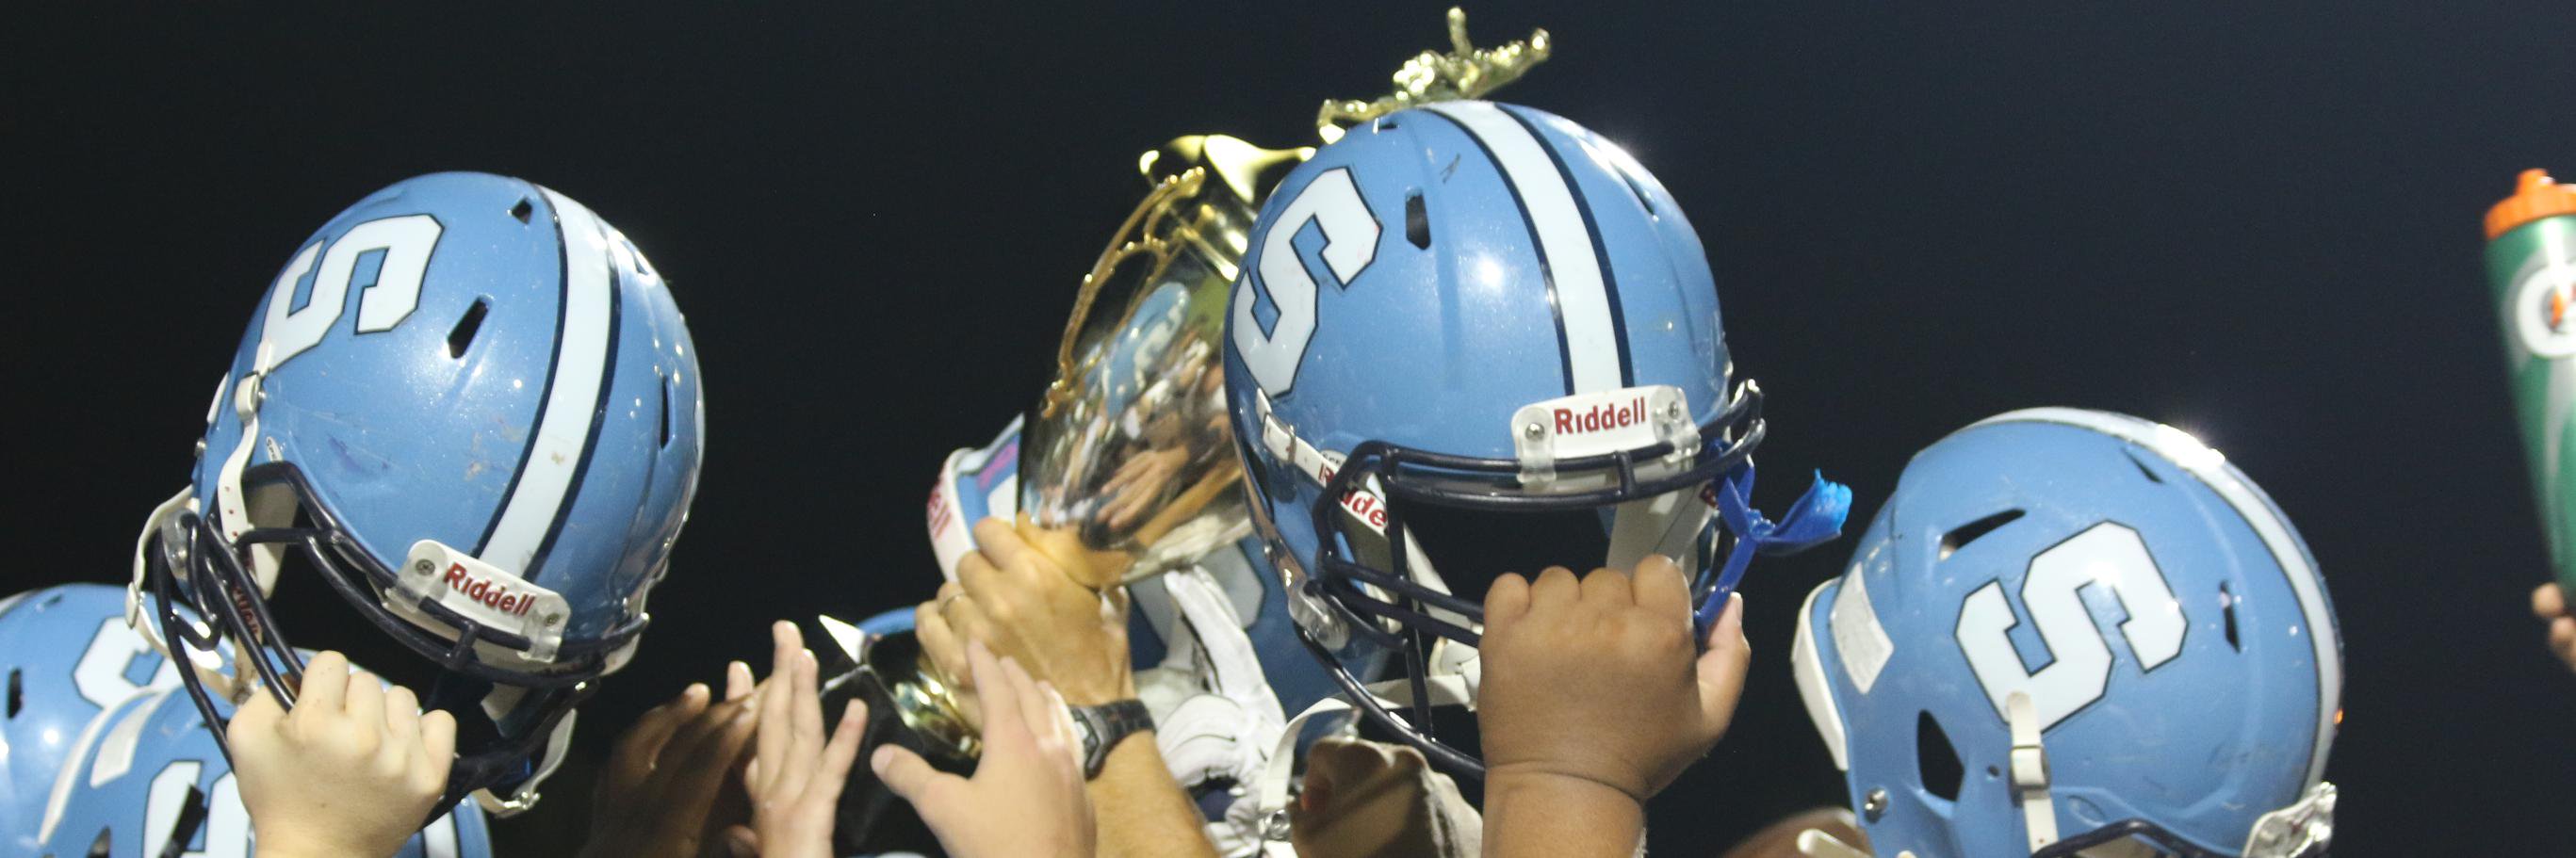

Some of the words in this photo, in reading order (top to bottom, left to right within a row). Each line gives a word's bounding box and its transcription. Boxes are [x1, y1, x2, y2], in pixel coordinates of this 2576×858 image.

[259, 213, 444, 371] S
[1233, 165, 1383, 397] S
[1554, 397, 1646, 435] Riddell
[443, 561, 536, 618] Riddell
[1955, 519, 2188, 734] S
